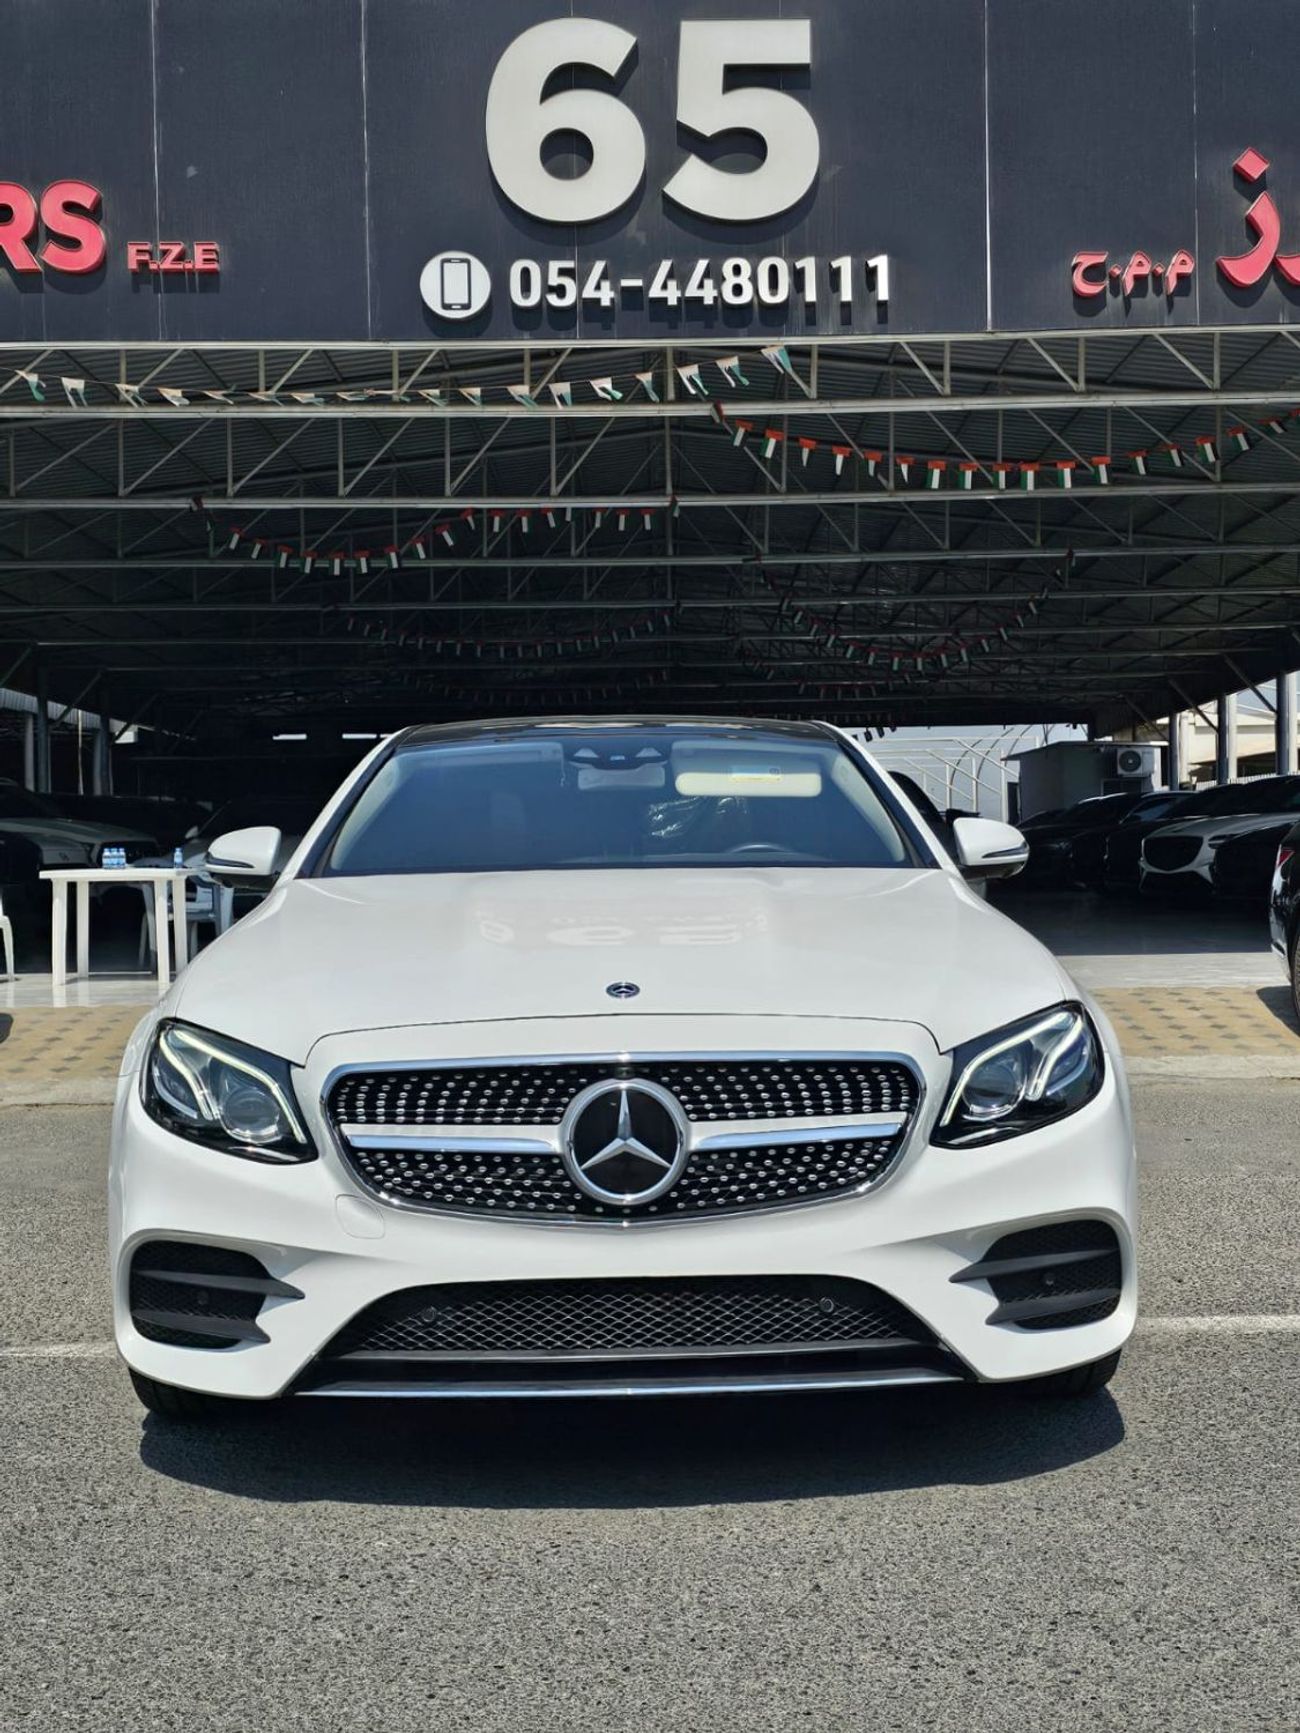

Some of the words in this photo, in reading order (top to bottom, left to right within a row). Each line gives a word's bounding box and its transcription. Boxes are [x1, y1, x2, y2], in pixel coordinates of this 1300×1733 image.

[486, 17, 820, 223] 65
[127, 241, 220, 273] F.Z.E
[509, 254, 890, 307] 054-4480111
